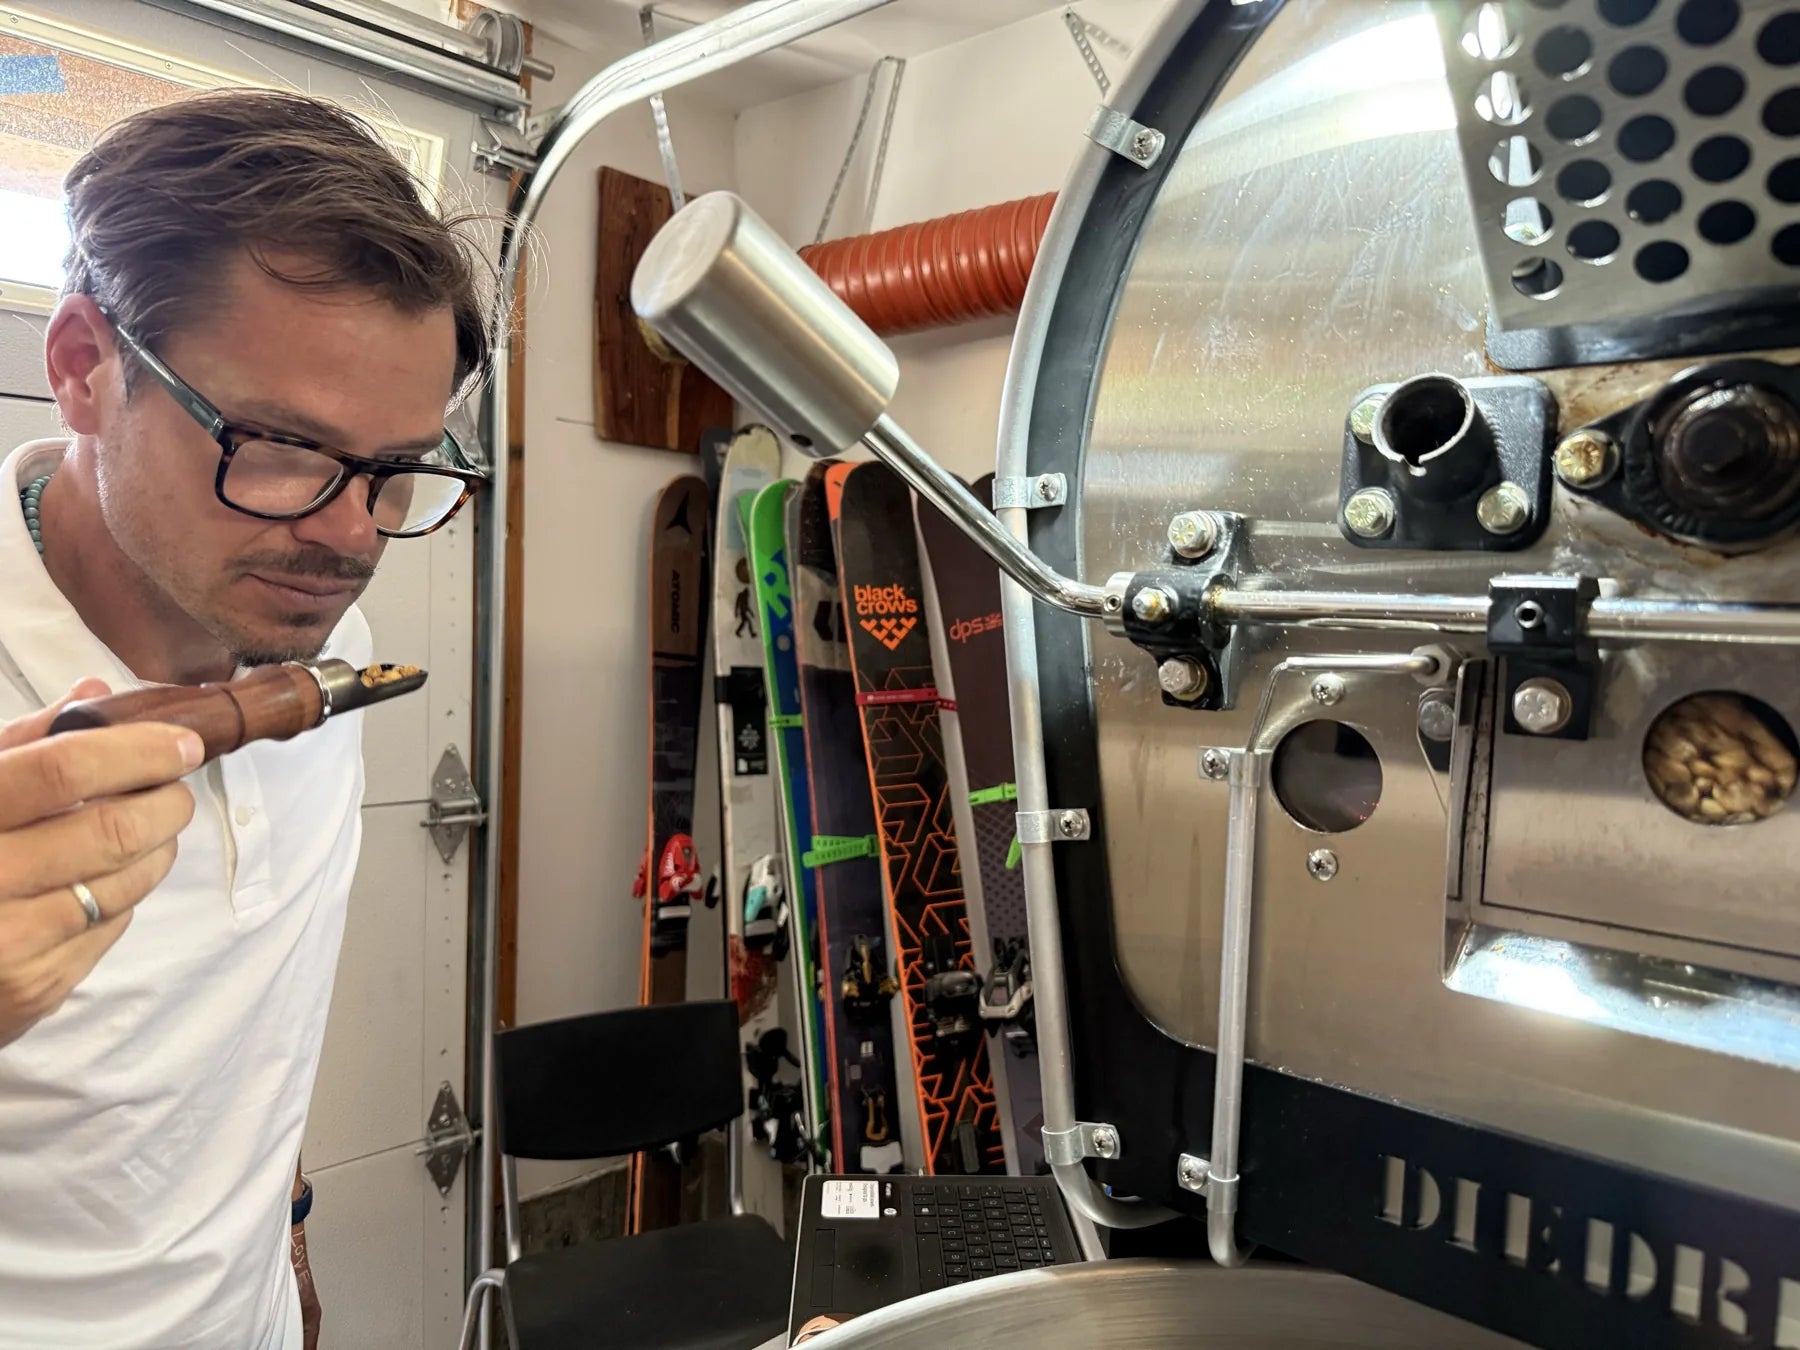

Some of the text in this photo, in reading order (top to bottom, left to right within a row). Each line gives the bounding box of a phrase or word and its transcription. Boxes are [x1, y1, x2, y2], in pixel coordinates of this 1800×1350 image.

[671, 569, 681, 634] ATOMIC
[854, 583, 906, 602] black
[856, 598, 918, 615] crows
[949, 617, 984, 644] dps
